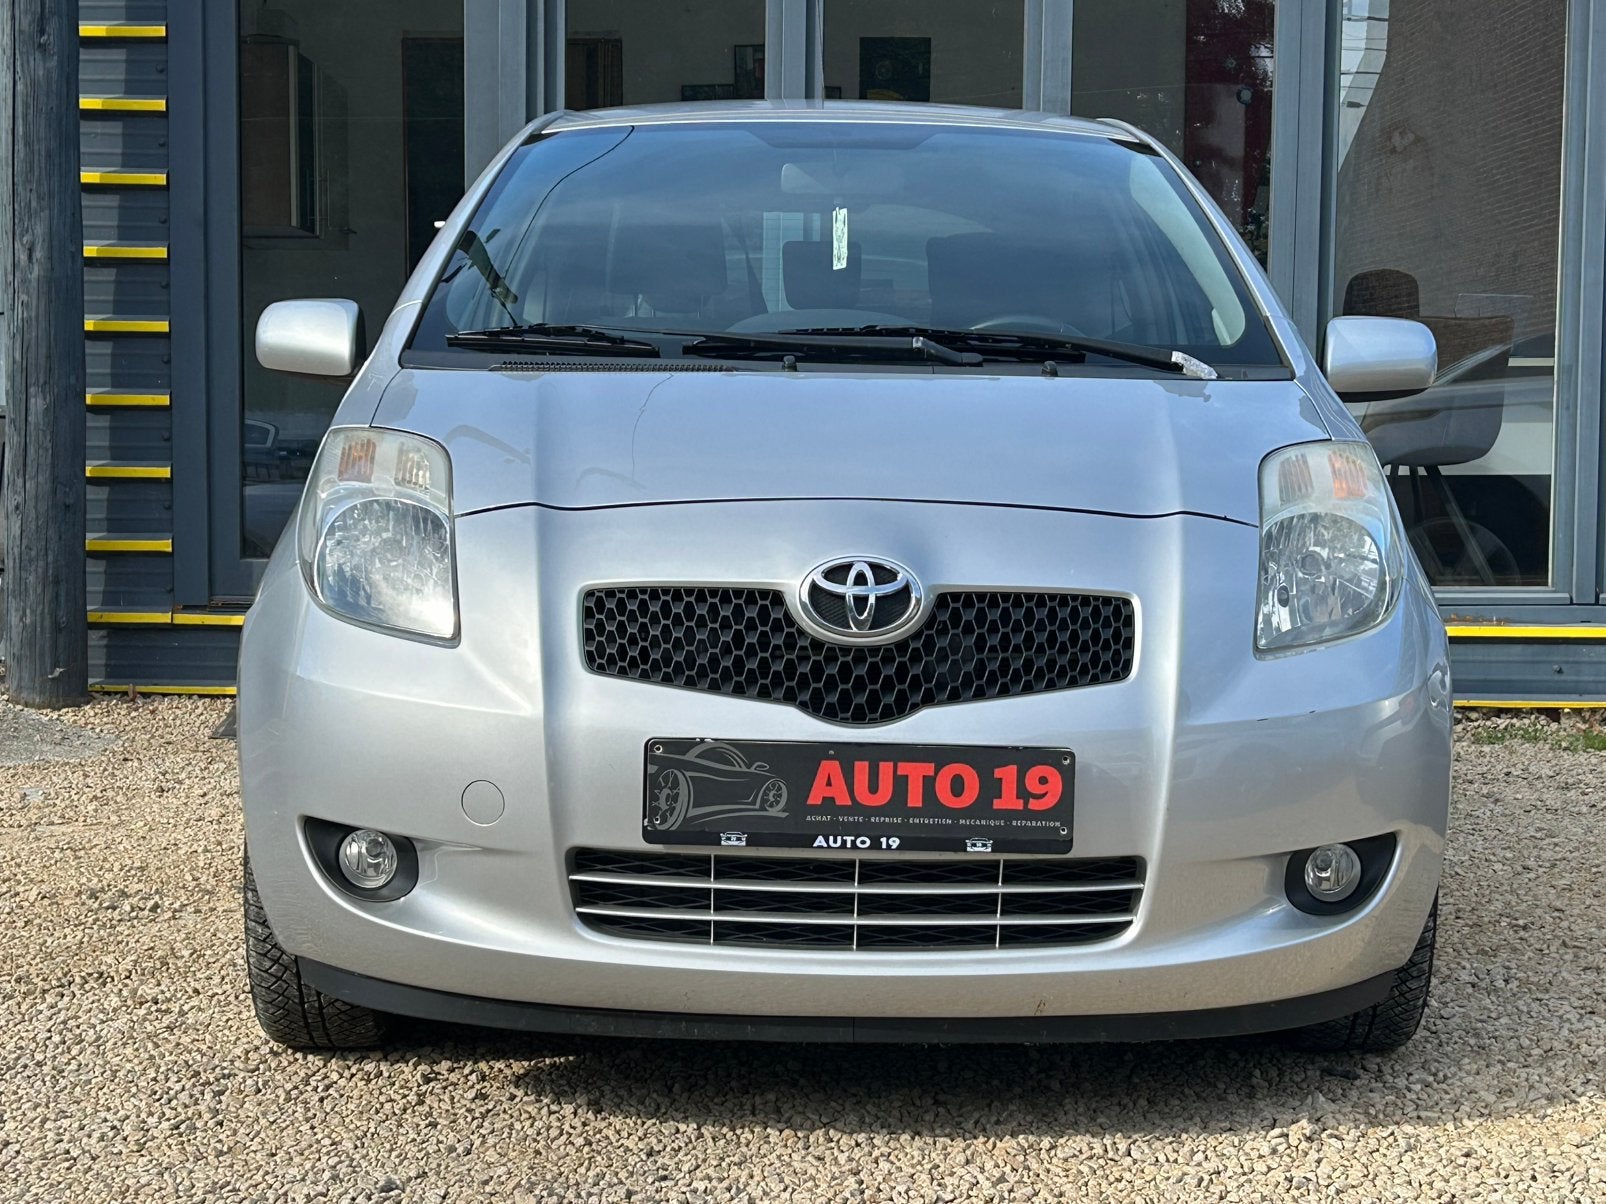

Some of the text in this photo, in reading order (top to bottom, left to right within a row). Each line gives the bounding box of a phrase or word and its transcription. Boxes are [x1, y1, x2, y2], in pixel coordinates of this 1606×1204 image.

[807, 759, 1063, 811] AUTO 19
[870, 816, 902, 824] REPRISE
[909, 817, 952, 825] ENTRETIEN
[812, 835, 901, 849] AUTO 19
